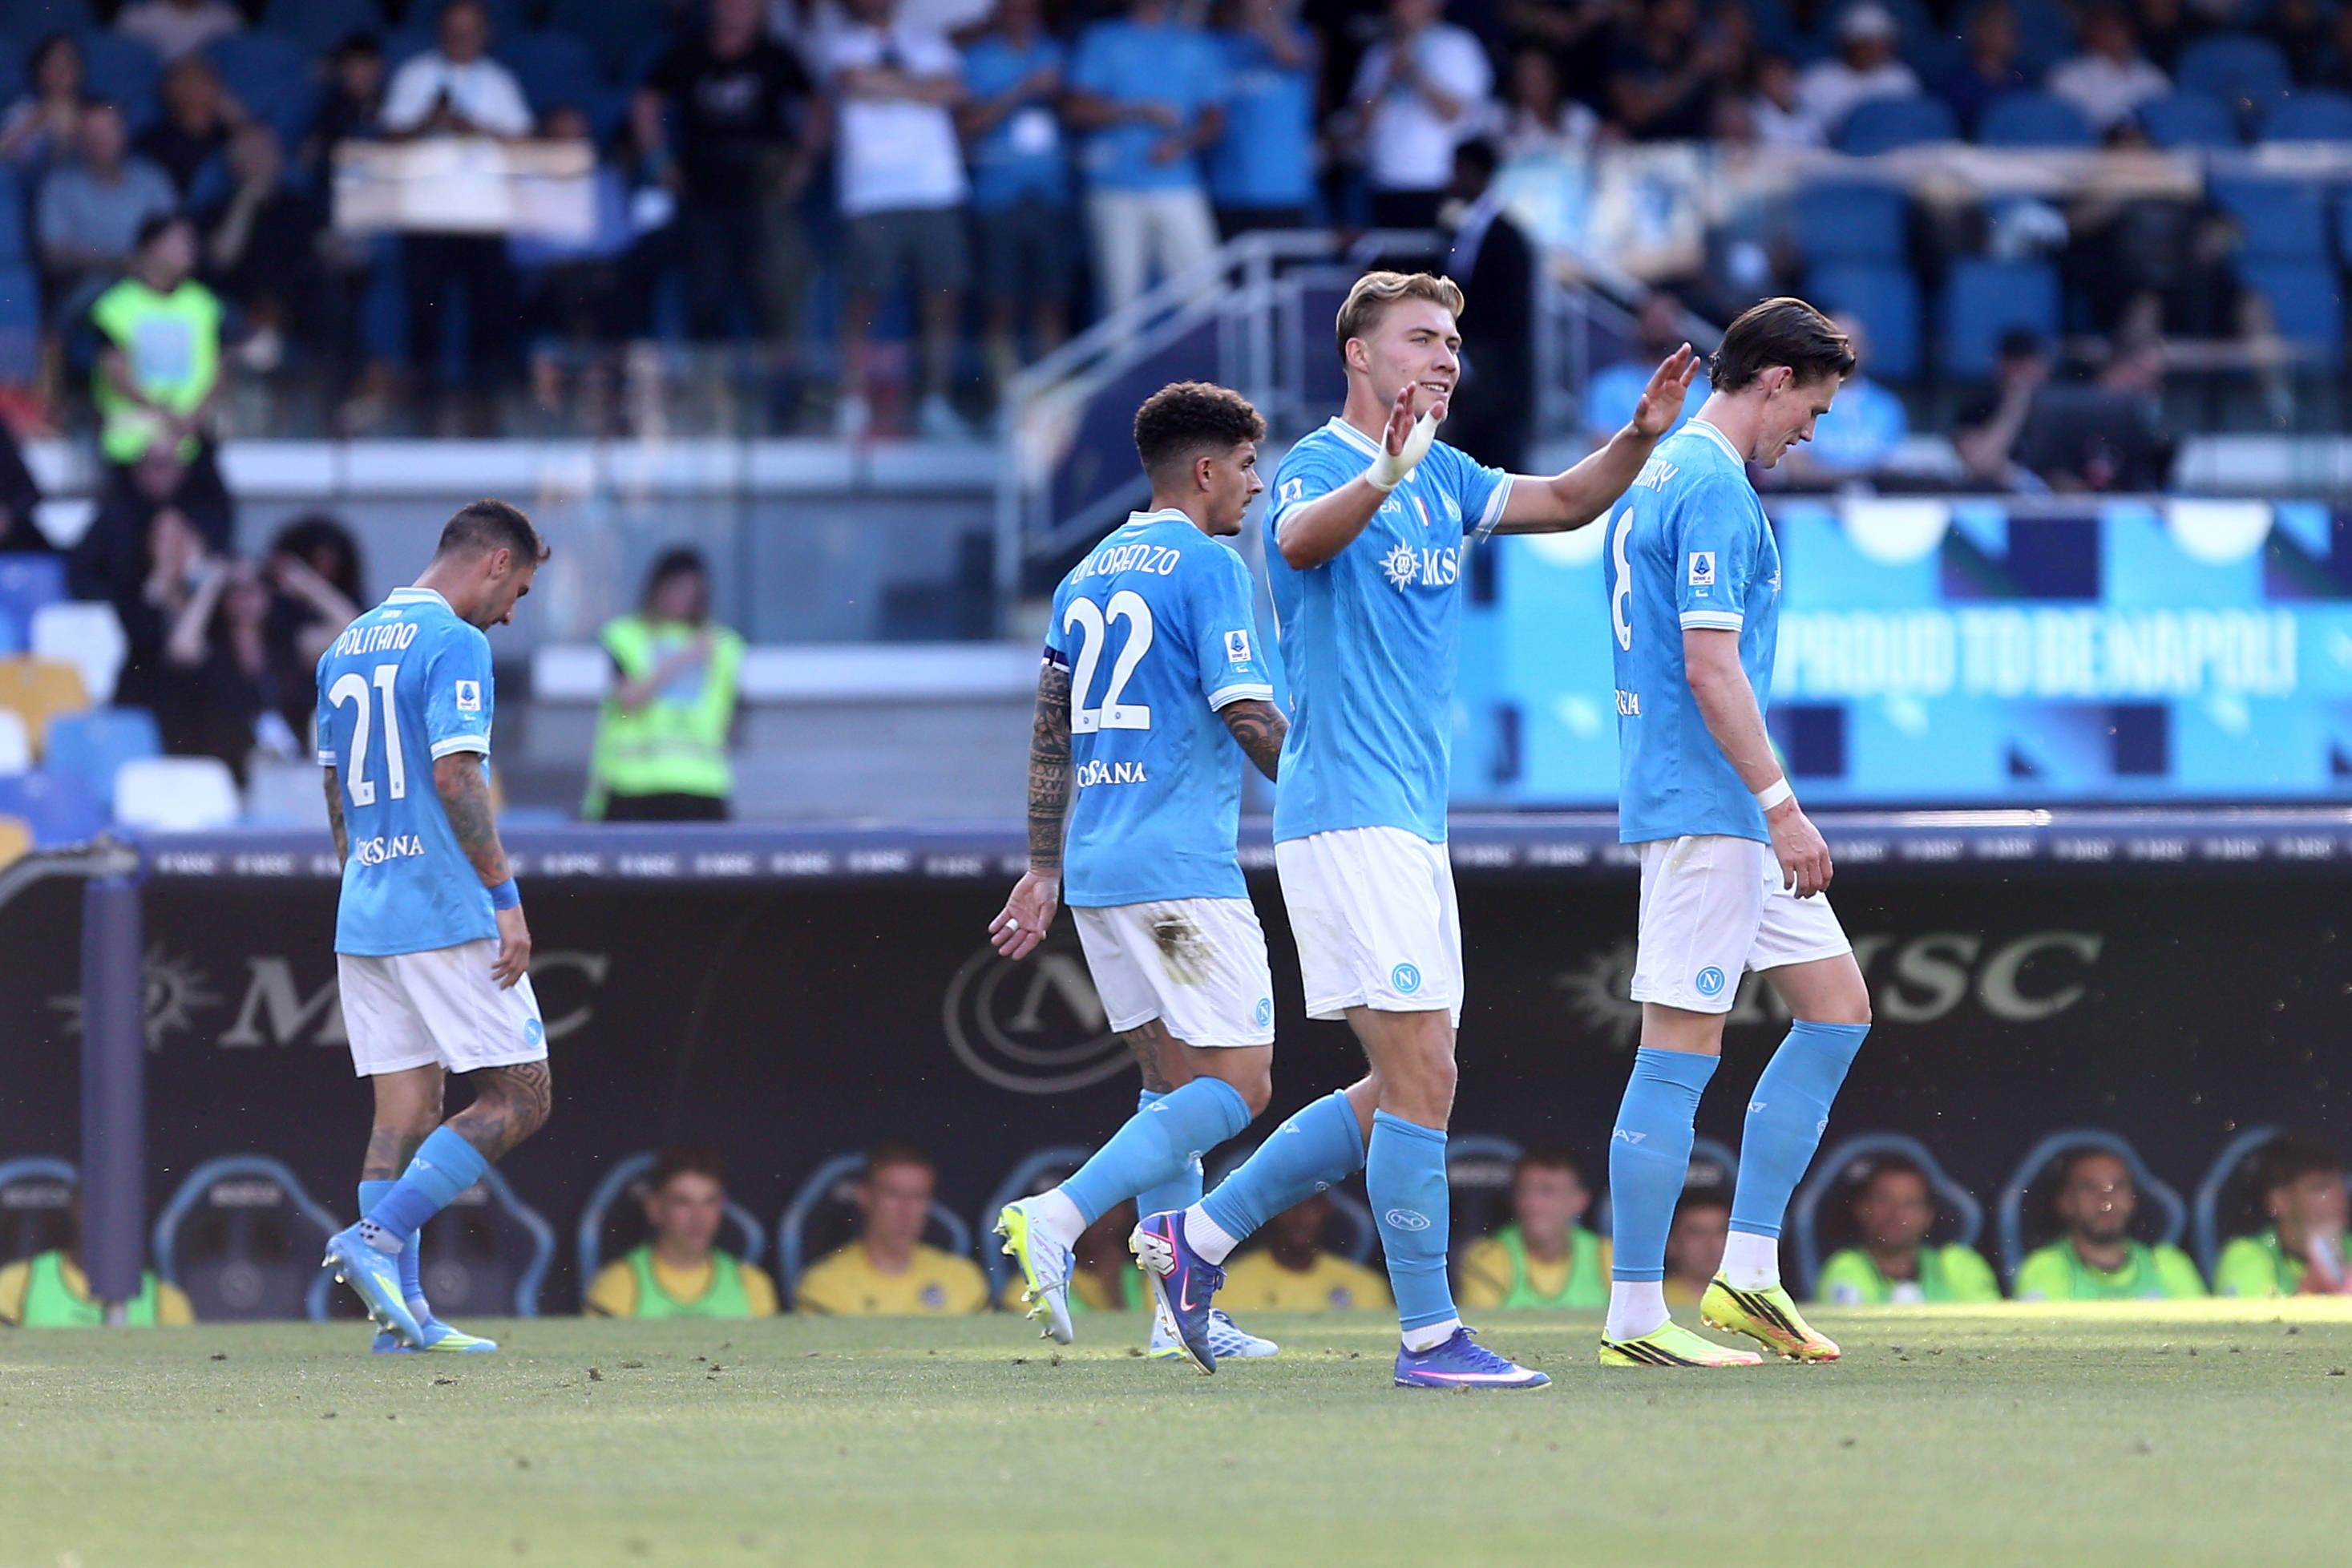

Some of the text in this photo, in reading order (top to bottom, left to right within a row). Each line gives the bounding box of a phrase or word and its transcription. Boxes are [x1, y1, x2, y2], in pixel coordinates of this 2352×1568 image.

[1086, 544, 1181, 576] LORENZO
[1421, 545, 1463, 585] MS
[334, 622, 418, 658] POLITANO
[1775, 608, 2297, 696] PROUD TO BE NAPOLI
[1063, 590, 1154, 734] 22
[328, 664, 406, 808] 21
[1612, 1126, 1647, 1145] A7
